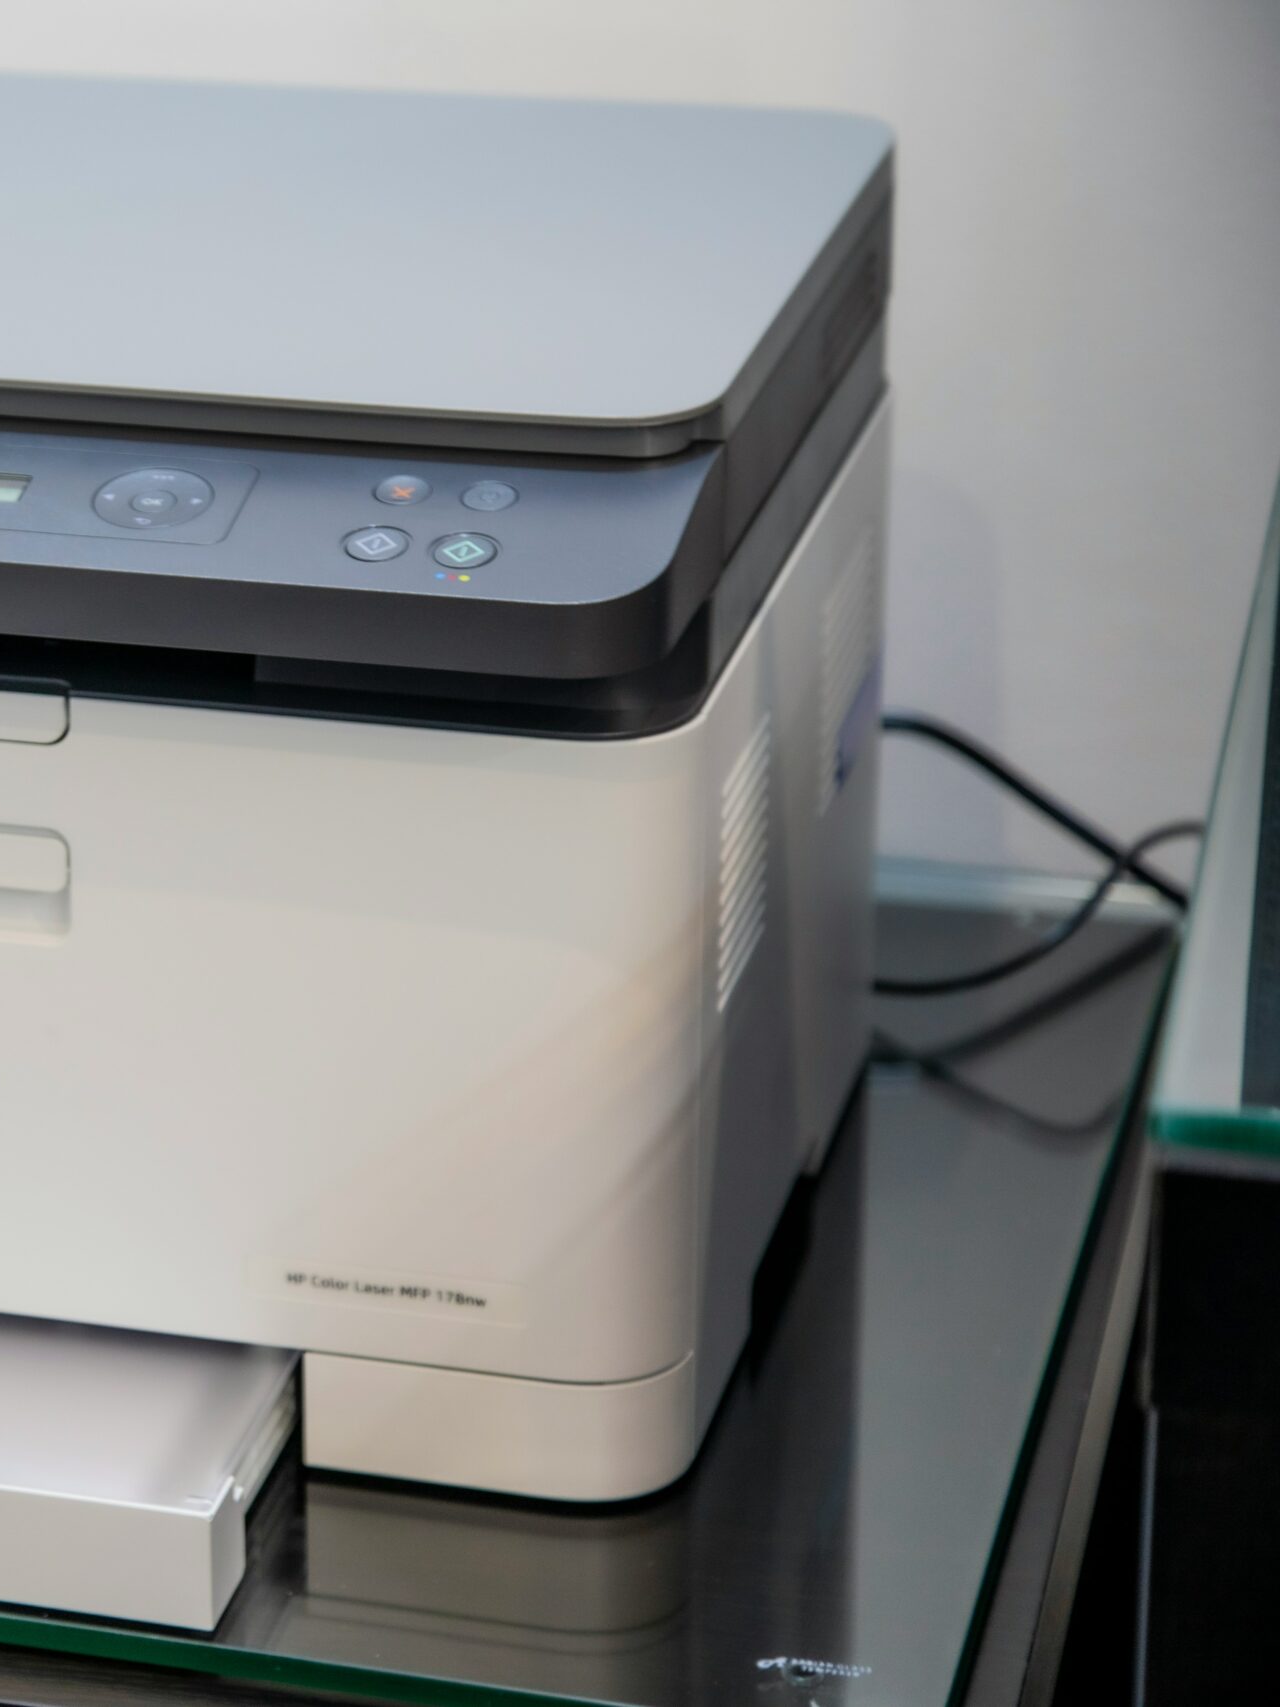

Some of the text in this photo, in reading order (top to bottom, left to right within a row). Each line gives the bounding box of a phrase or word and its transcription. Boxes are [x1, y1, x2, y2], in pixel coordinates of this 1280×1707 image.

[141, 497, 163, 507] OK
[286, 1273, 487, 1307] HP Color Laser MFP 178nw
